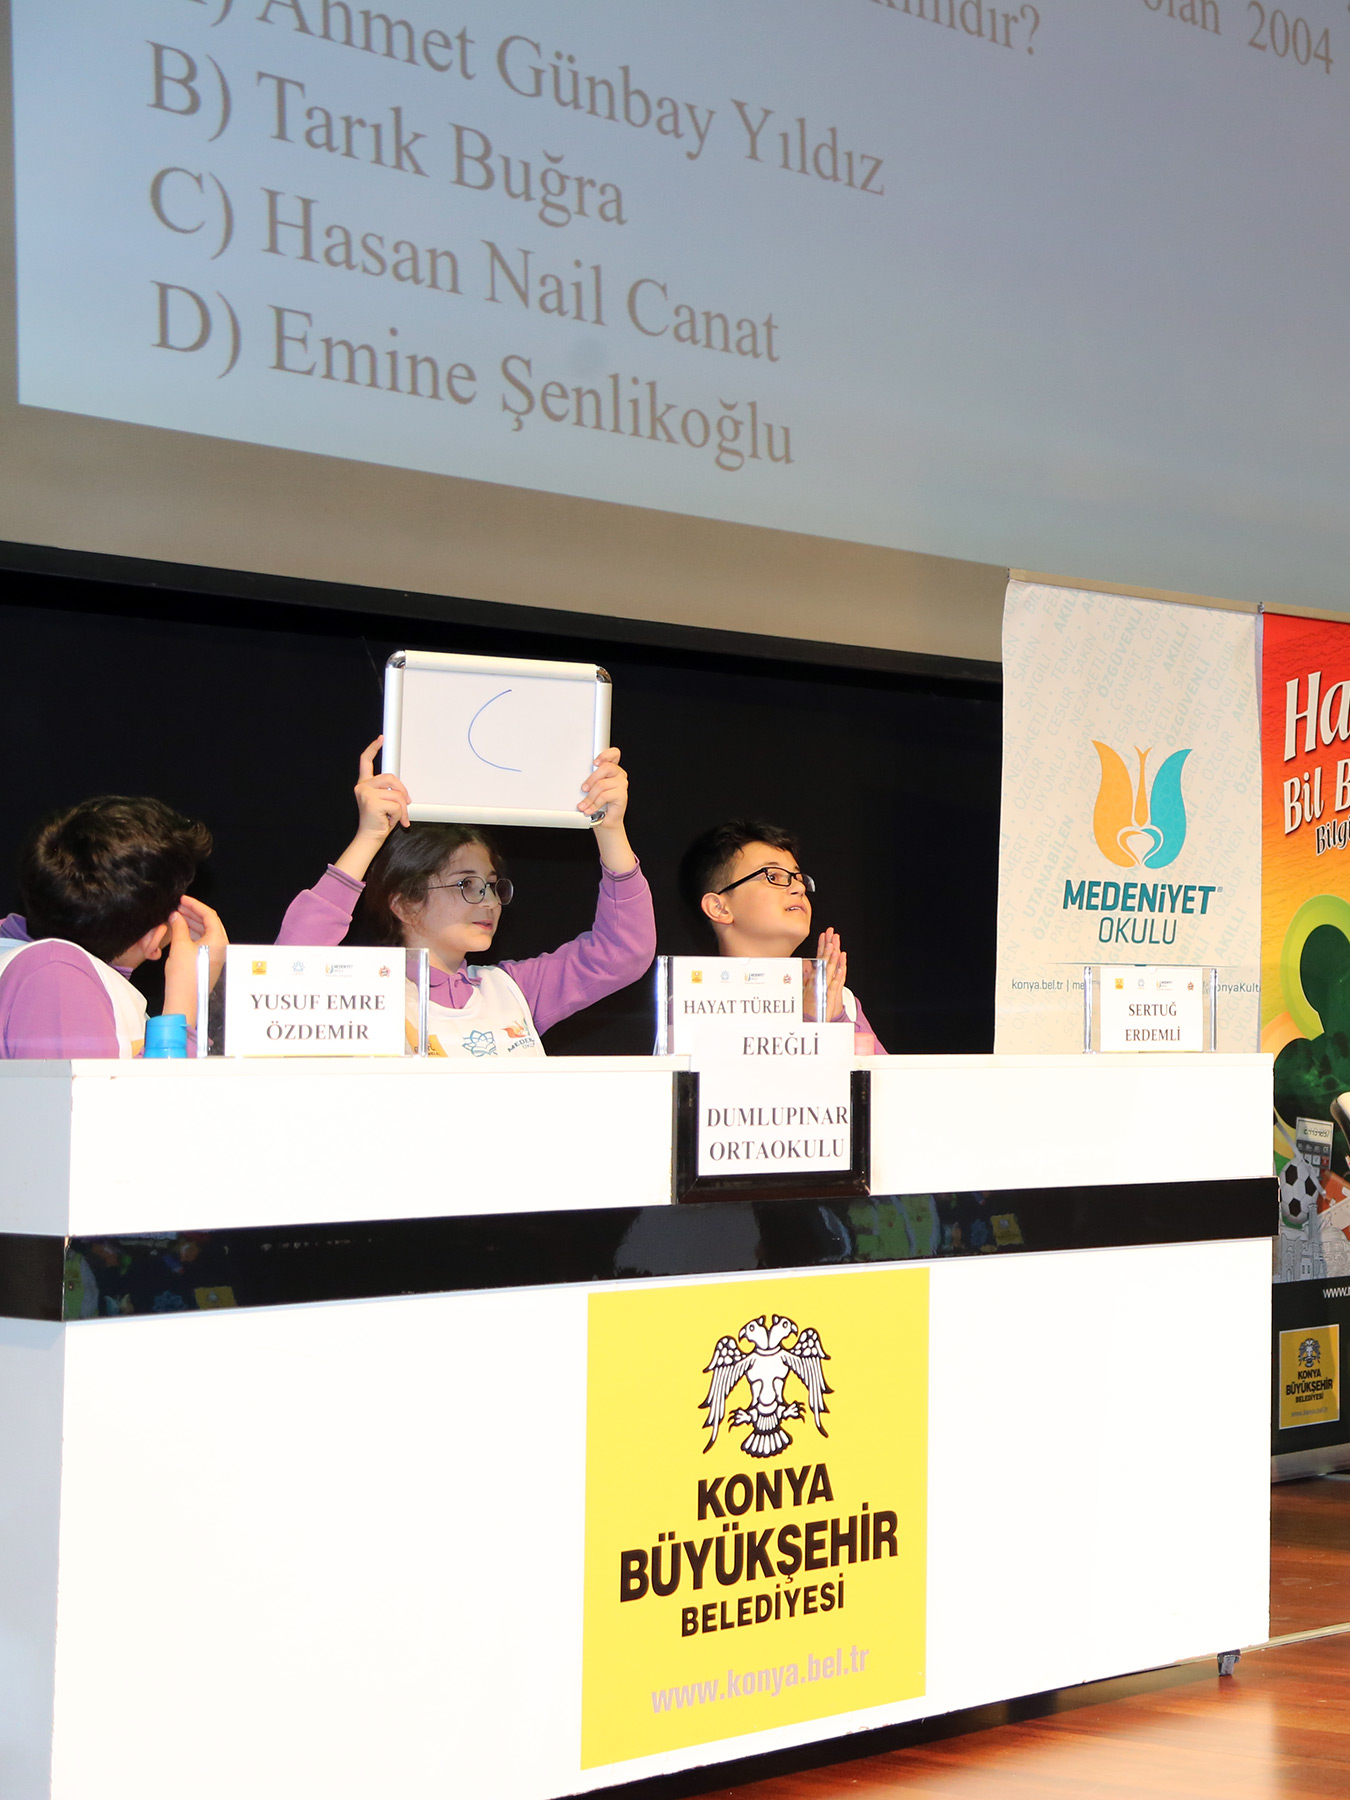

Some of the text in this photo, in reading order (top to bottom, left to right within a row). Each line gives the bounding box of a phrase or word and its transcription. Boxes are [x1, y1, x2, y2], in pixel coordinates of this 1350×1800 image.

[1248, 0, 1334, 75] 2004
[145, 39, 628, 228] B) Tarık Buğra
[496, 34, 717, 161] Günbay
[730, 99, 886, 196] Yıldız
[149, 165, 781, 363] C) Hasan Nail Canat
[150, 279, 797, 472] D) Emine Şenlikoğlu
[467, 688, 523, 774] C
[1283, 766, 1325, 836] Bil
[1098, 916, 1178, 945] OKULU
[250, 993, 386, 1011] YUSUF EMRE
[683, 996, 796, 1014] HAYAT TÜRELİ
[1011, 979, 1063, 992] konya.bel.tr
[265, 1020, 370, 1041] ÖZDEMİR
[1128, 1001, 1178, 1017] SERTUĞ
[743, 1032, 821, 1056] EREĞLİ
[1125, 1026, 1181, 1042] ERDEMLİ
[707, 1106, 849, 1127] DUMLUPINAR
[709, 1138, 845, 1161] ORTAOKULU
[1297, 1368, 1322, 1380] KONYA
[697, 1462, 835, 1521] KONYA
[620, 1502, 900, 1604] BÜYÜKŞEHİR
[681, 1573, 846, 1639] BELEDİYESİ
[651, 1644, 870, 1715] www.konya.bel.tr
